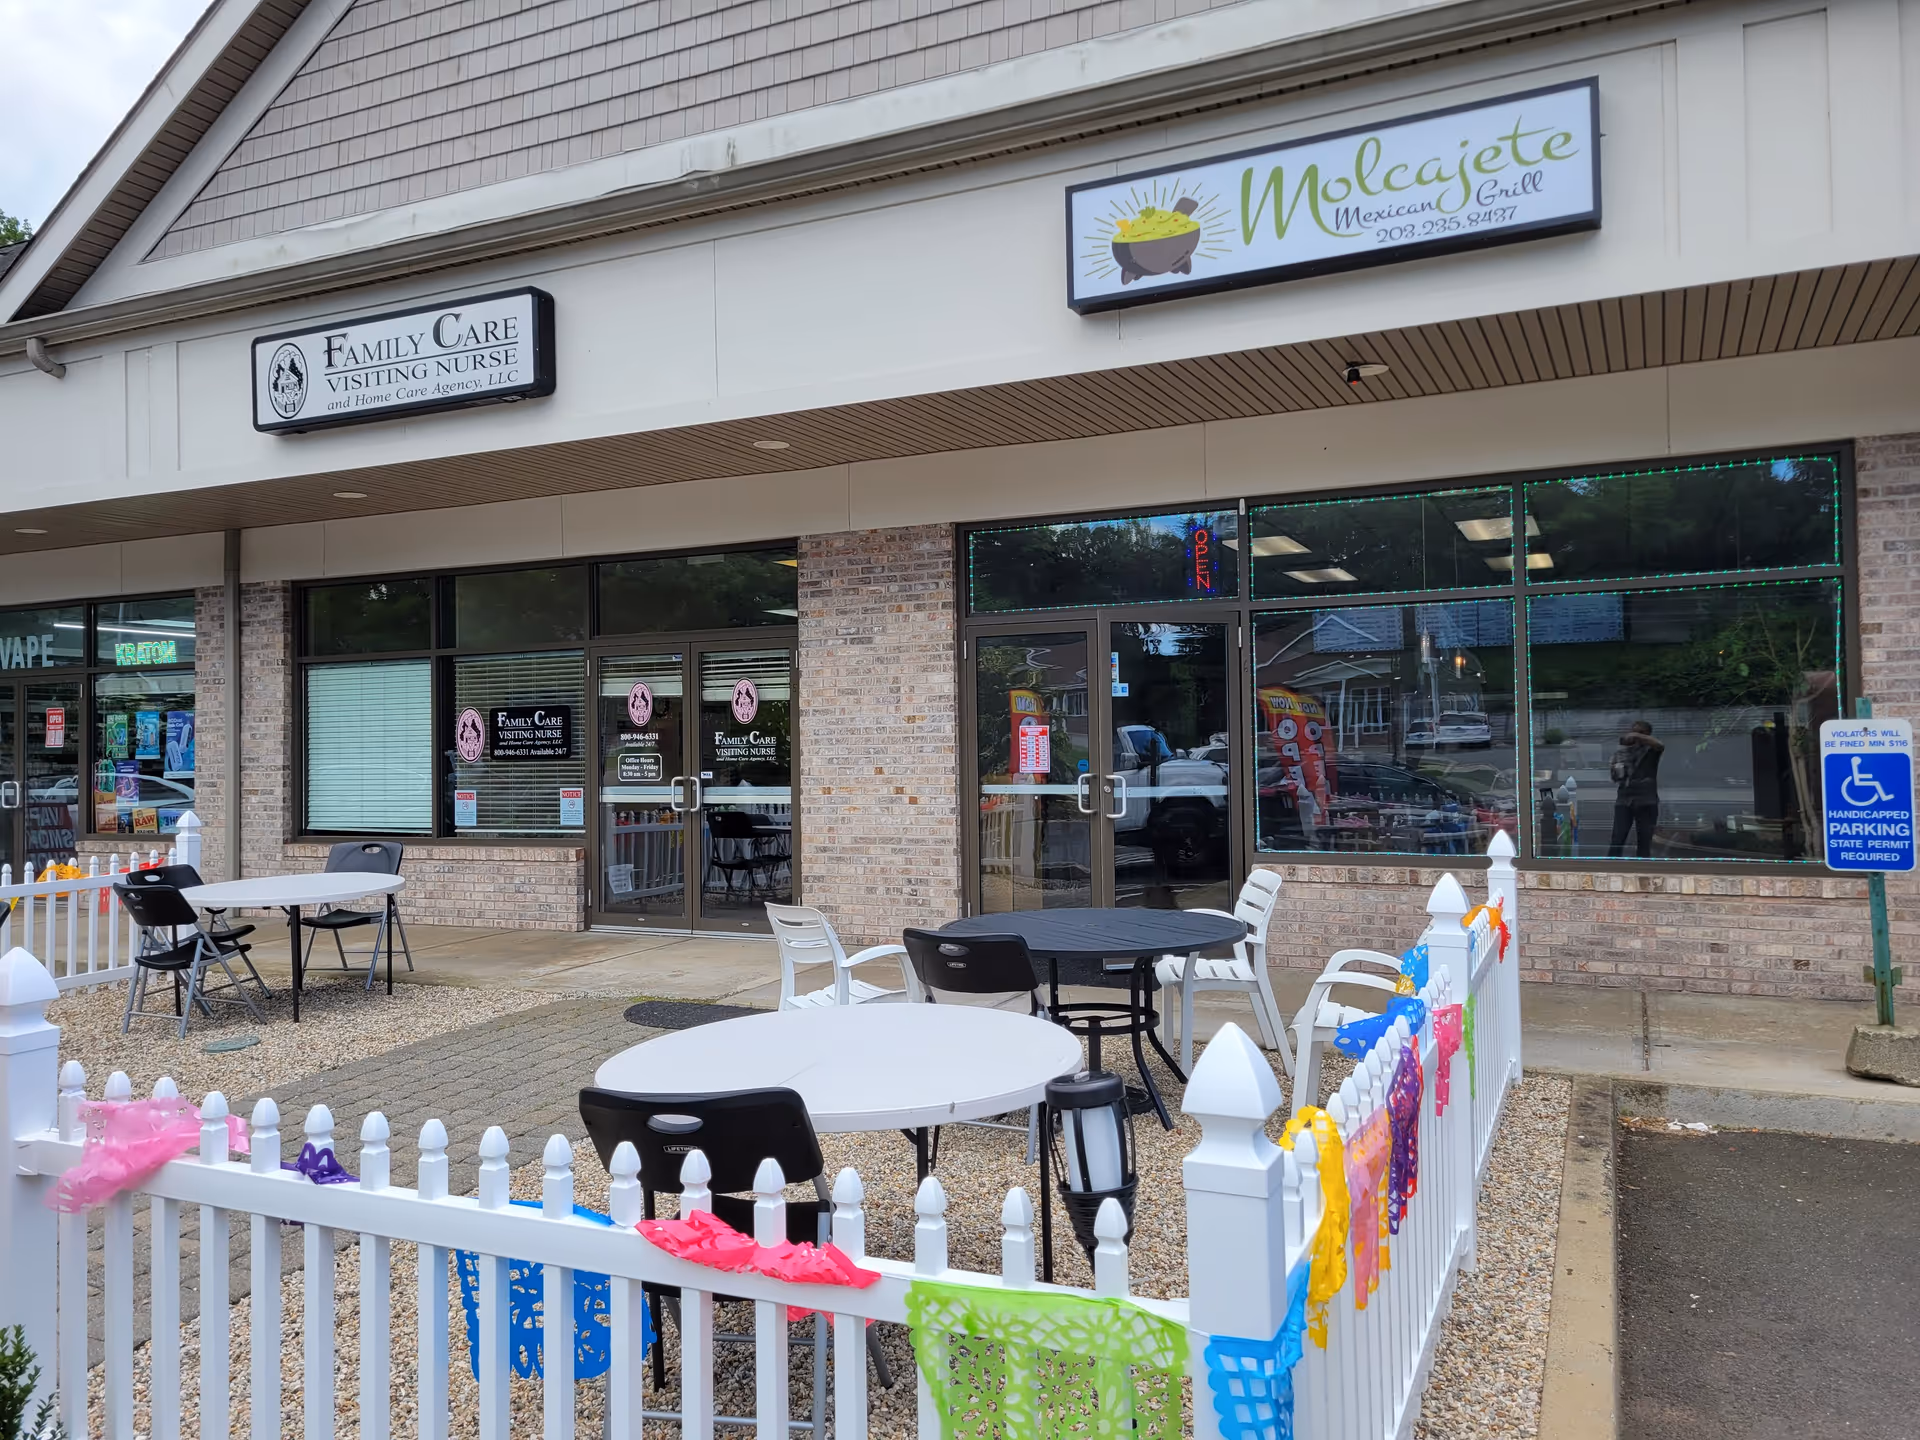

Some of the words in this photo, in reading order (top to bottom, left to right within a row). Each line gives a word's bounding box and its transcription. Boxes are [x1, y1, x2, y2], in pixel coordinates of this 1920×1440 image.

[1240, 114, 1580, 246] Molcajete
[1334, 200, 1436, 232] Mexican
[1475, 170, 1543, 207] Grill
[432, 311, 520, 350] CARE
[326, 363, 429, 394] VISITING
[435, 348, 518, 378] NURSE
[327, 399, 351, 411] and
[354, 393, 392, 407] Home
[395, 385, 428, 400] Care
[431, 378, 483, 396] Agency,
[487, 370, 519, 387] LLC
[1194, 528, 1211, 590] OPEN
[0, 634, 54, 669] VAPE
[115, 640, 177, 666] KRATOM
[498, 730, 533, 739] VISITING
[535, 729, 562, 738] NURSE
[554, 747, 567, 755] 24/7
[715, 747, 749, 756] VISITING
[750, 747, 776, 756] NURSE
[134, 815, 156, 828] RAW
[1828, 810, 1909, 819] HANDICAPPED
[1829, 823, 1910, 836] PARKING
[1830, 840, 1863, 848] STATE
[1867, 840, 1910, 849] PERMIT
[1840, 852, 1900, 861] REQUIRED
